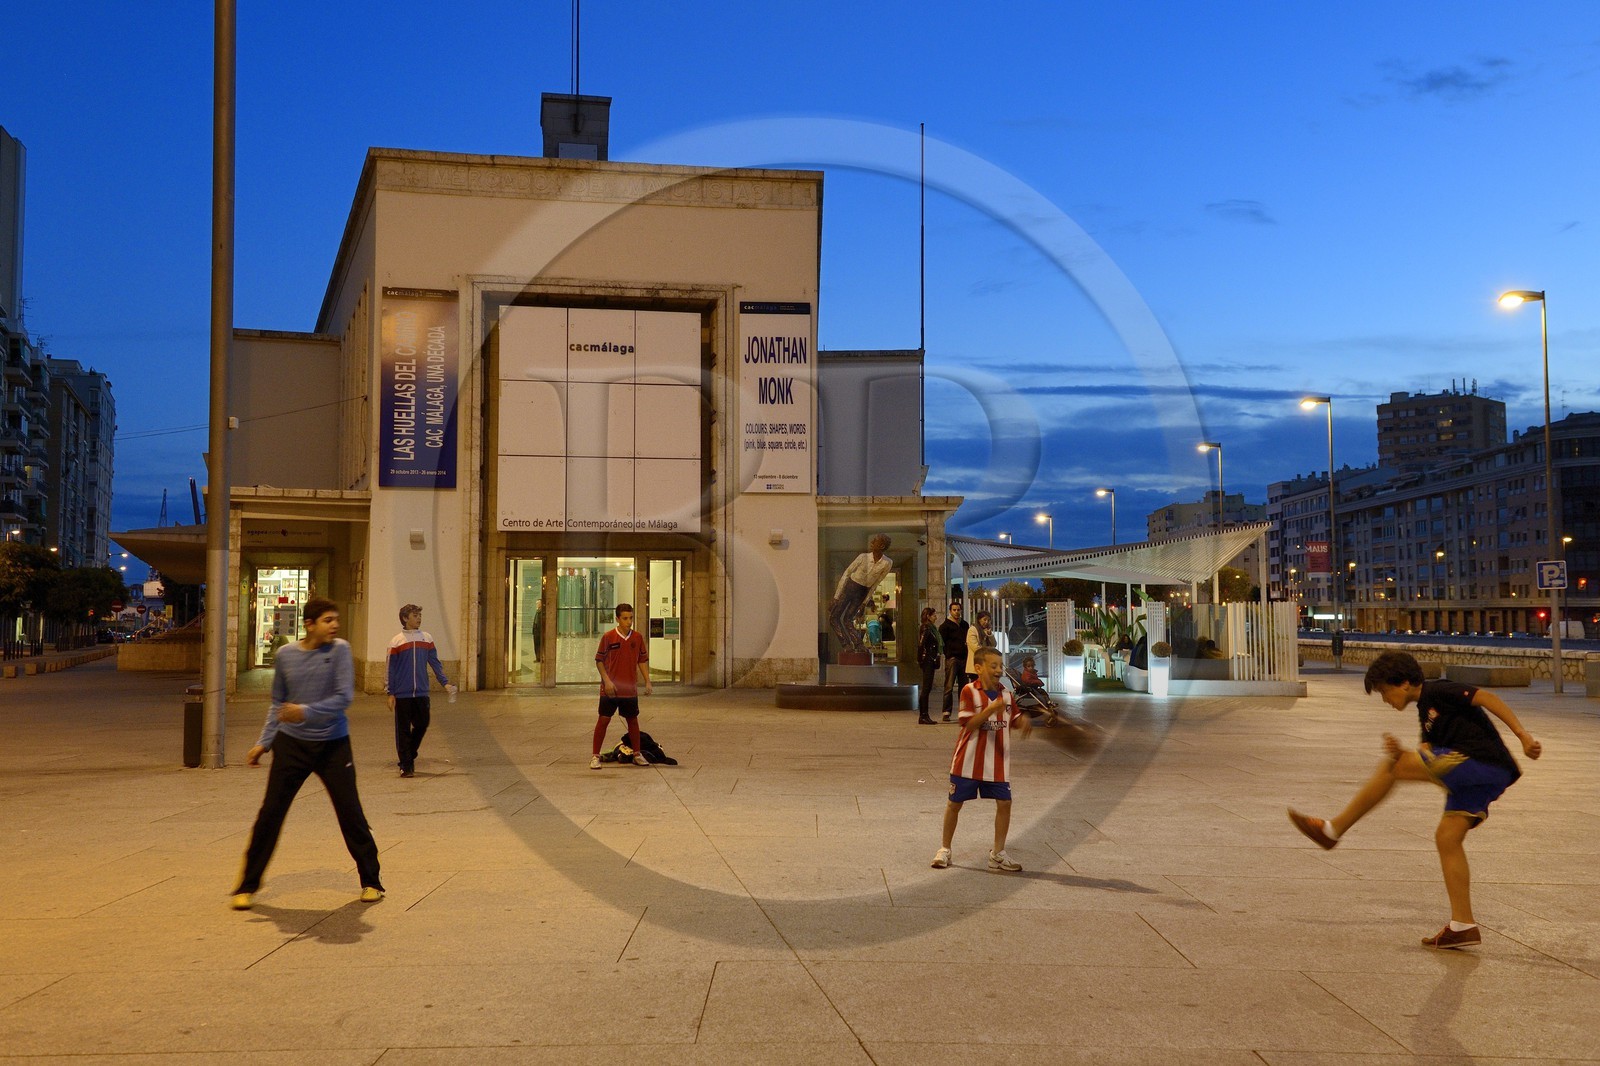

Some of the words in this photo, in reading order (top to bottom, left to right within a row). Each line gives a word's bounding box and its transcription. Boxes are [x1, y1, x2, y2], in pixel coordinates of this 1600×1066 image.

[423, 326, 445, 362] DÉCADA
[569, 342, 635, 355] cacmálaga
[744, 336, 807, 364] JONATHAN
[394, 359, 416, 380] DEL
[426, 364, 444, 383] UNA
[758, 377, 794, 405] MONK
[393, 384, 416, 435] HUELLAS
[421, 385, 447, 424] MÁLAGA,
[425, 429, 444, 448] CAC
[745, 423, 768, 436] COLOURS,
[769, 424, 788, 436] SHAPES,
[789, 424, 806, 434] WORDS
[393, 438, 416, 460] LAS
[744, 439, 756, 452] (pink,
[756, 439, 767, 450] blue,
[768, 440, 784, 452] square,
[784, 439, 797, 451] circle,
[502, 518, 532, 528] Centro
[532, 518, 543, 528] de
[545, 519, 564, 528] Arte
[567, 518, 633, 531] Contemporáneo
[635, 519, 646, 529] de
[648, 519, 678, 531] Málaga
[1304, 544, 1328, 553] MAUS
[1542, 564, 1560, 586] P
